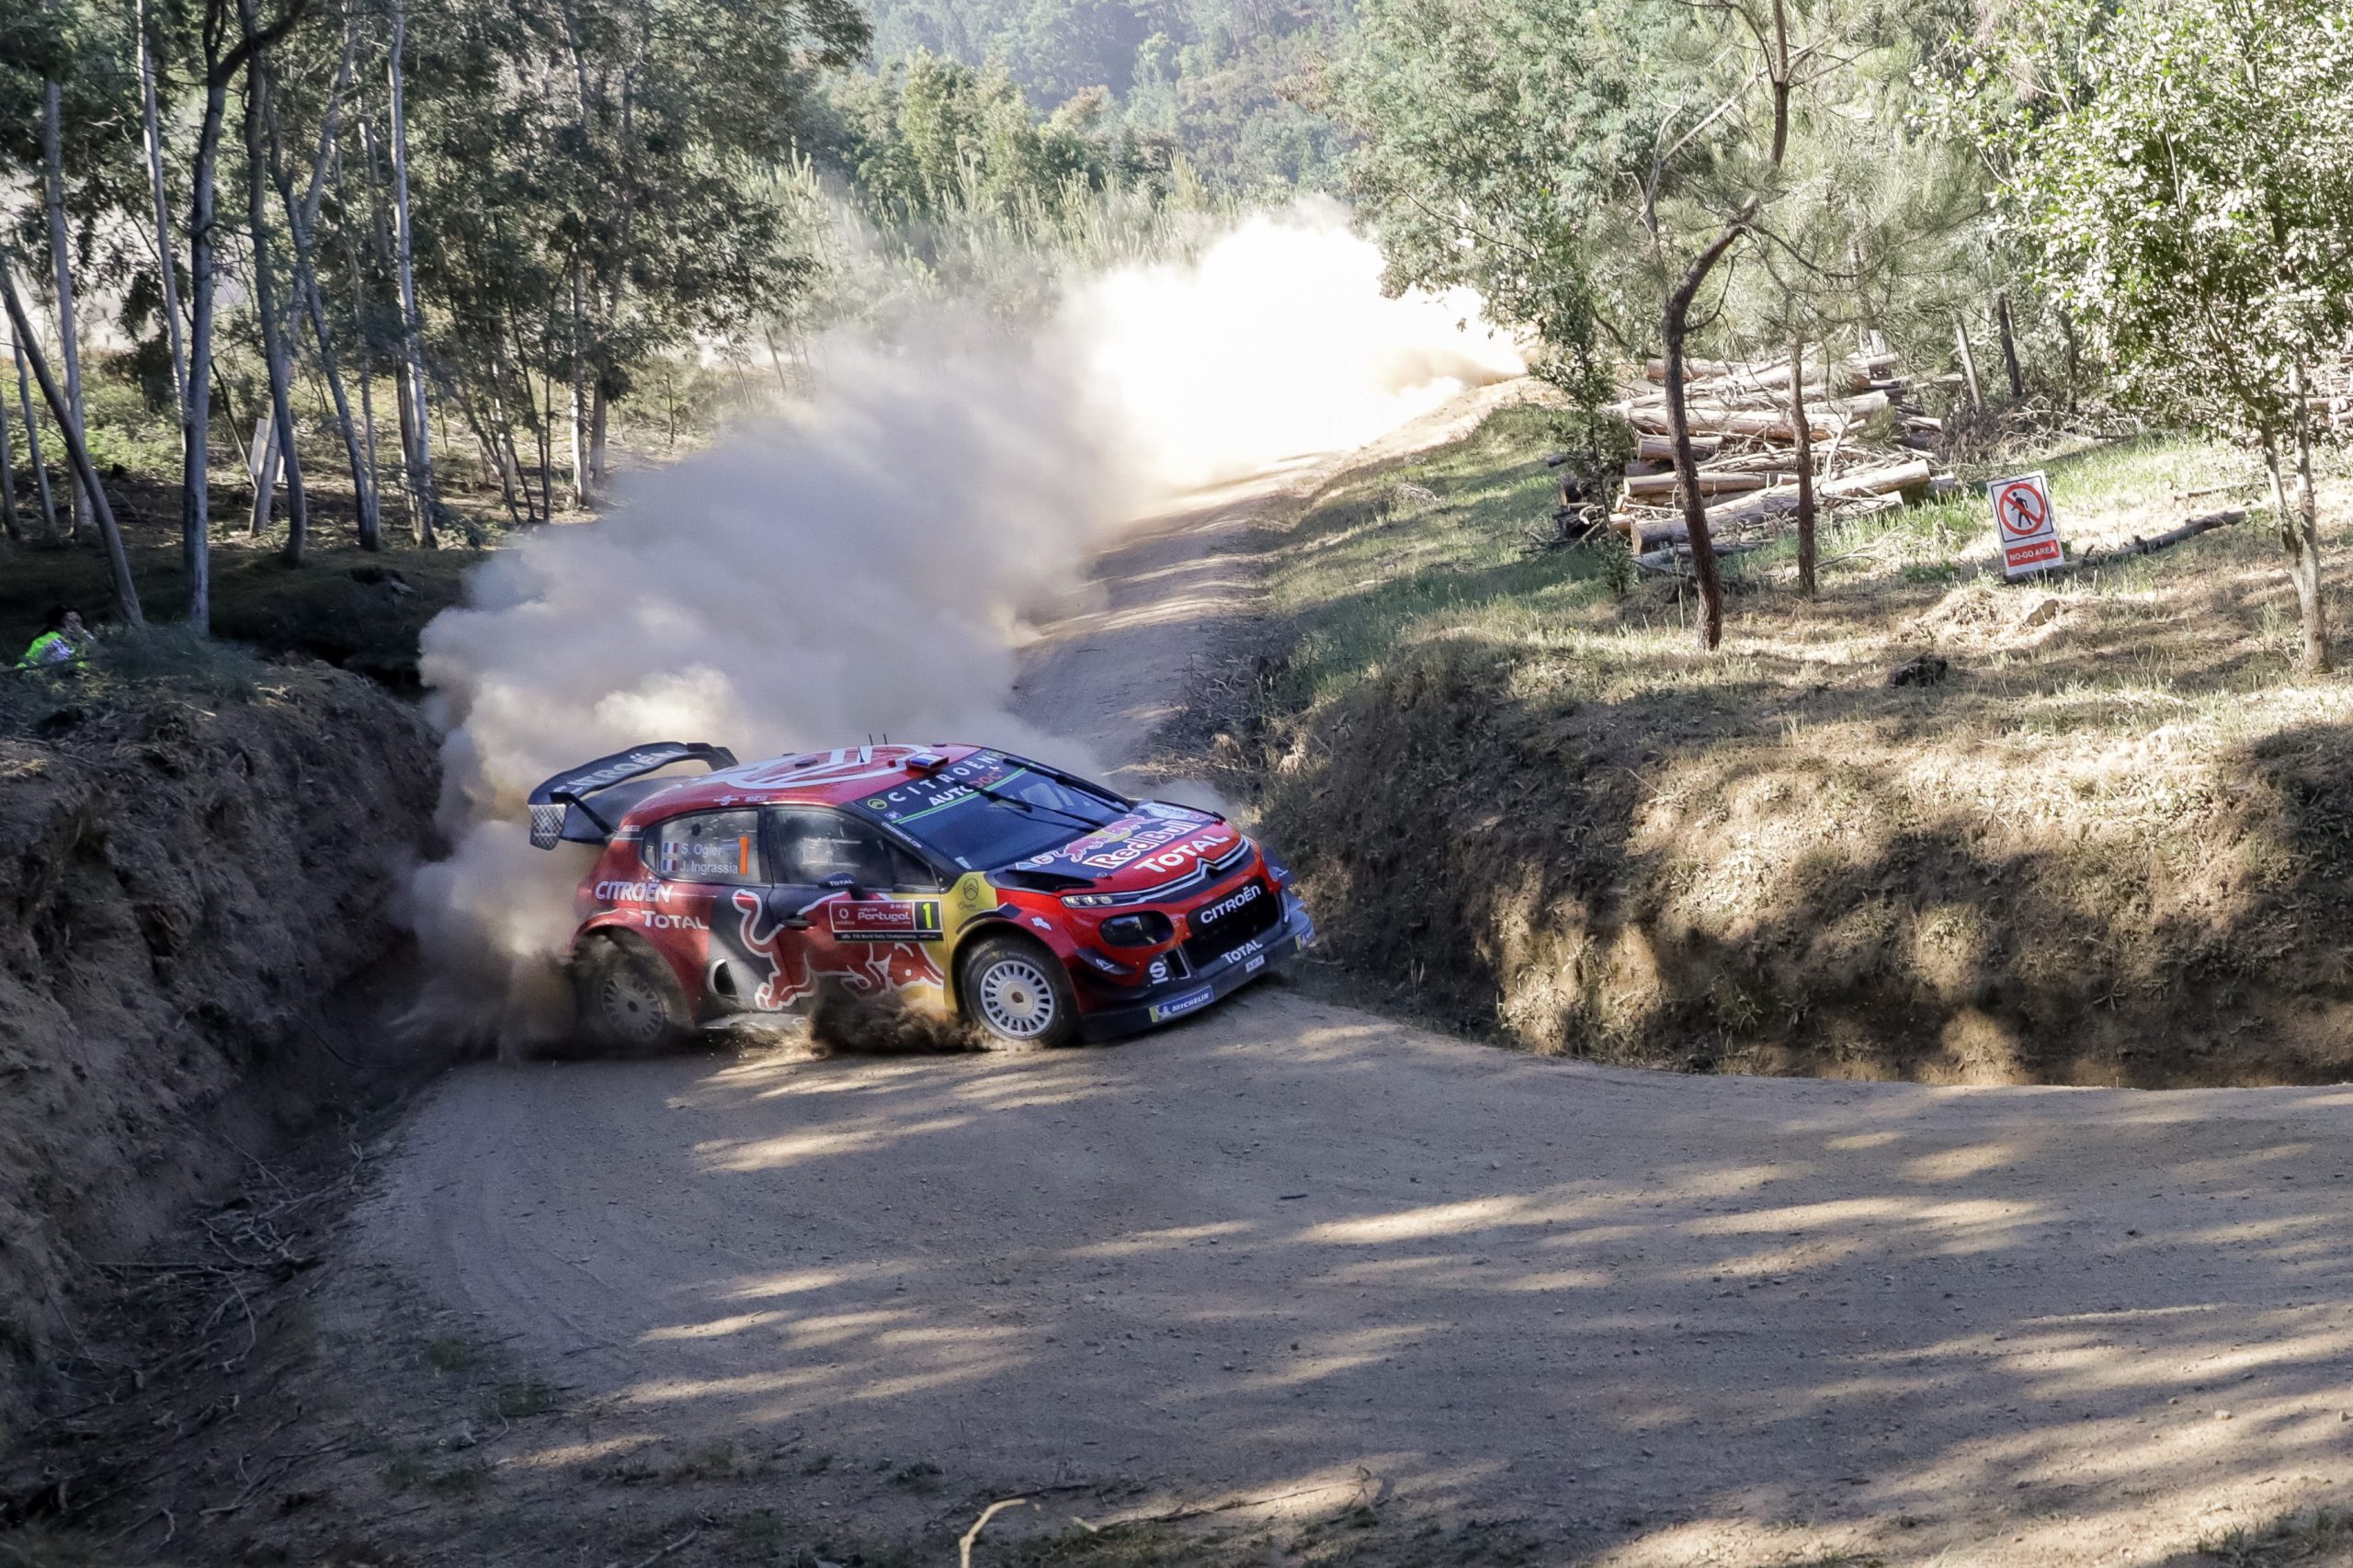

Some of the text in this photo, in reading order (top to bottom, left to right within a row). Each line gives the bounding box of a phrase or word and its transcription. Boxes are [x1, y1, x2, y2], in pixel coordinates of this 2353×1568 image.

[2009, 546, 2056, 562] NO-GO AREA
[1134, 835, 1229, 873] TOTAL
[691, 860, 739, 876] Ingrassia
[595, 879, 674, 903] CITROËN
[828, 879, 854, 887] TOTAL
[1200, 884, 1261, 924] CITROËN
[641, 910, 710, 930] TOTAL
[922, 903, 932, 929] 1
[1221, 939, 1263, 965] TOTAL
[1172, 992, 1210, 1013] MICHELIN
